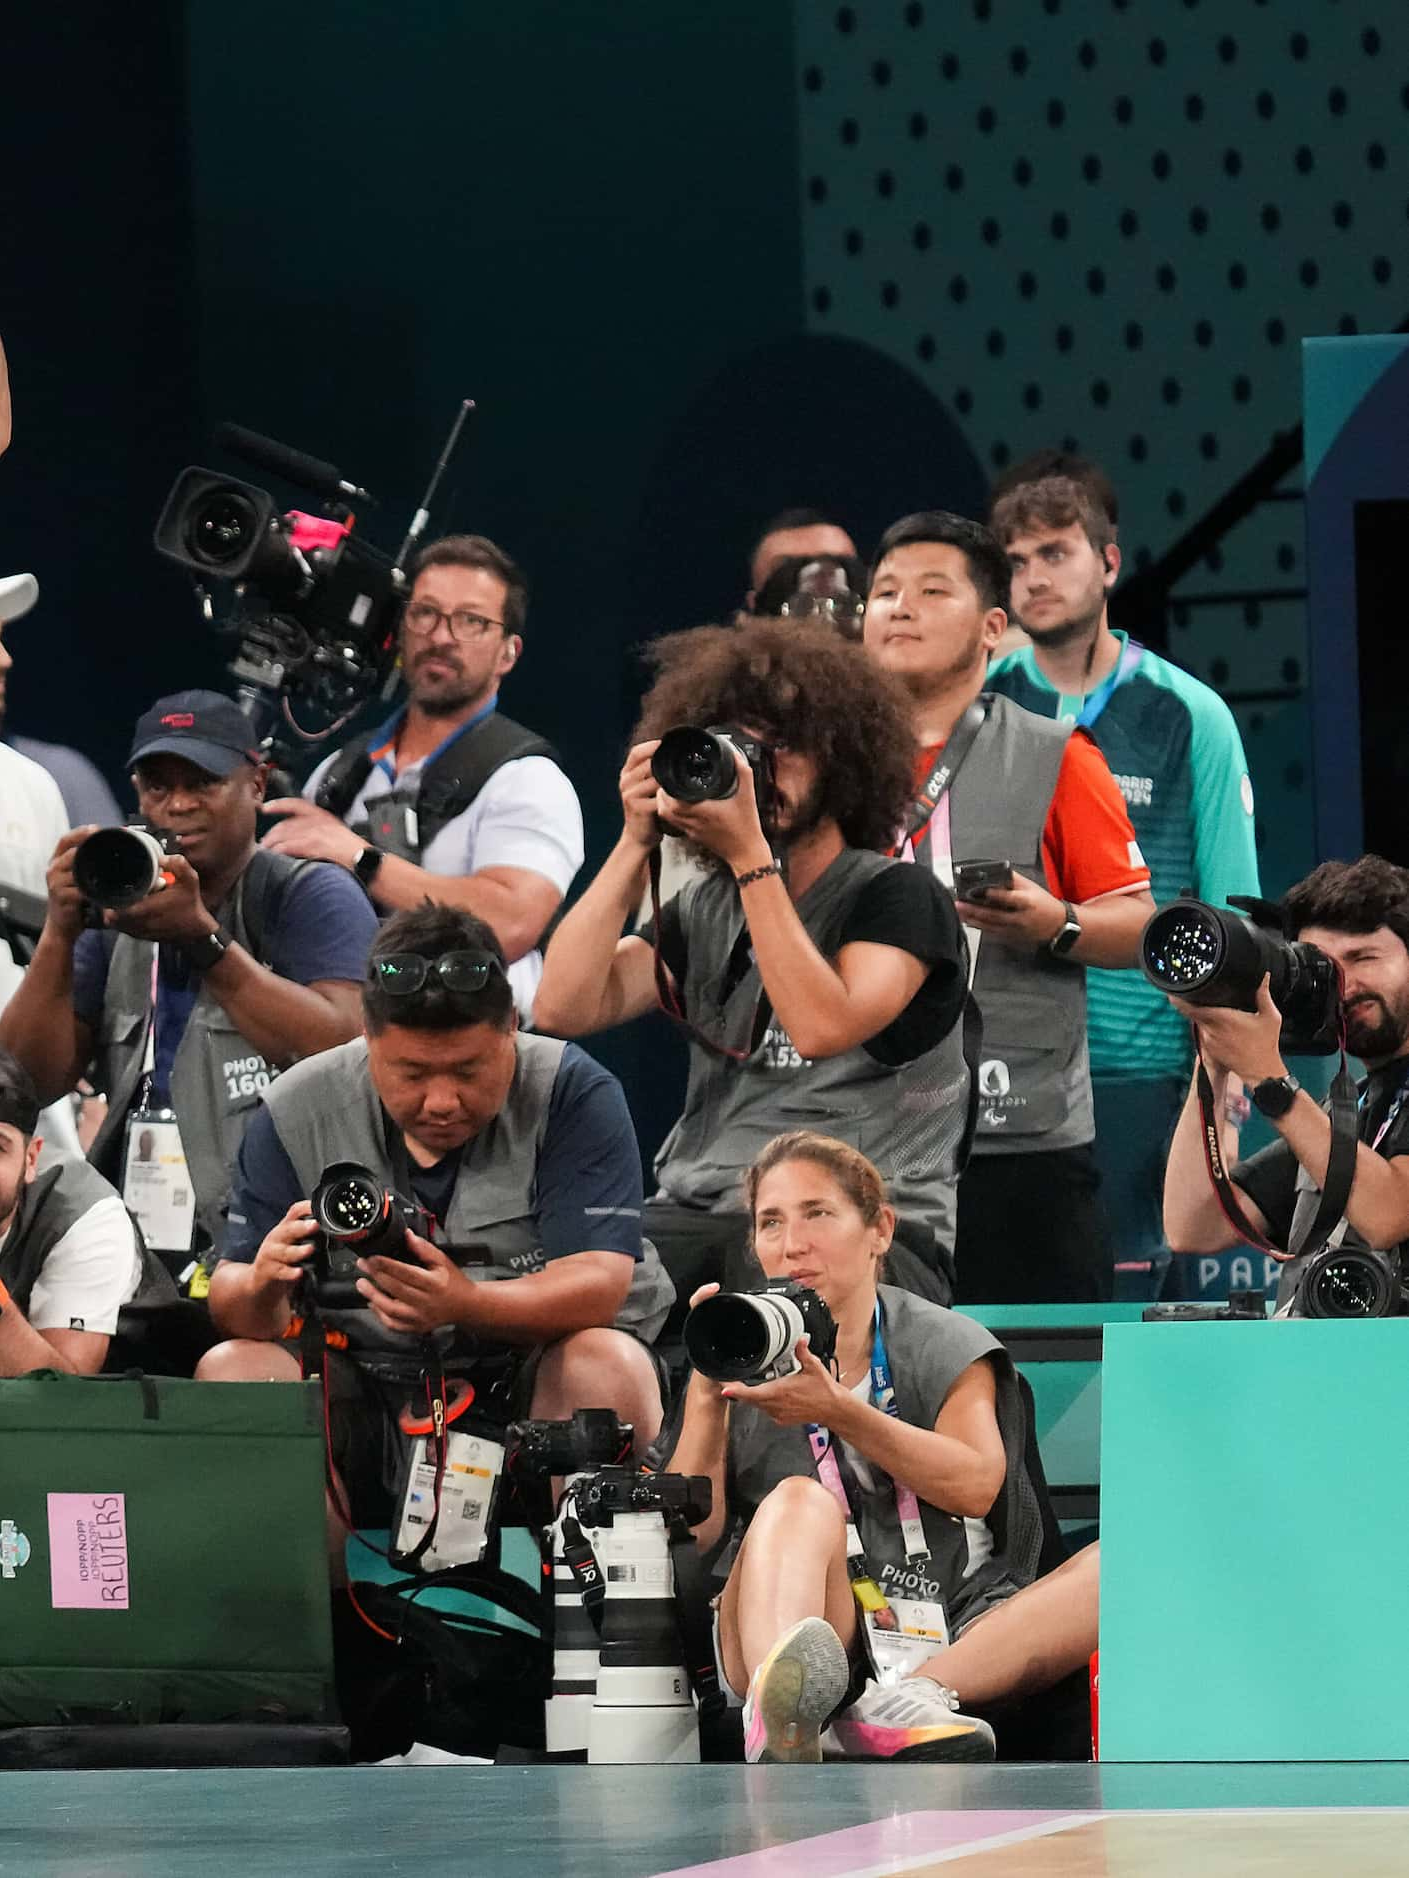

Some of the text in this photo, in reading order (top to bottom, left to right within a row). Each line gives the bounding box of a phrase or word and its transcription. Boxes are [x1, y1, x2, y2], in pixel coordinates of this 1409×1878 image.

[1207, 1125, 1223, 1180] Canon
[1198, 1256, 1283, 1289] PAR
[76, 1519, 89, 1582] IOPP/NOPP
[93, 1497, 127, 1602] REUTERS
[881, 1563, 940, 1597] PHOTO
